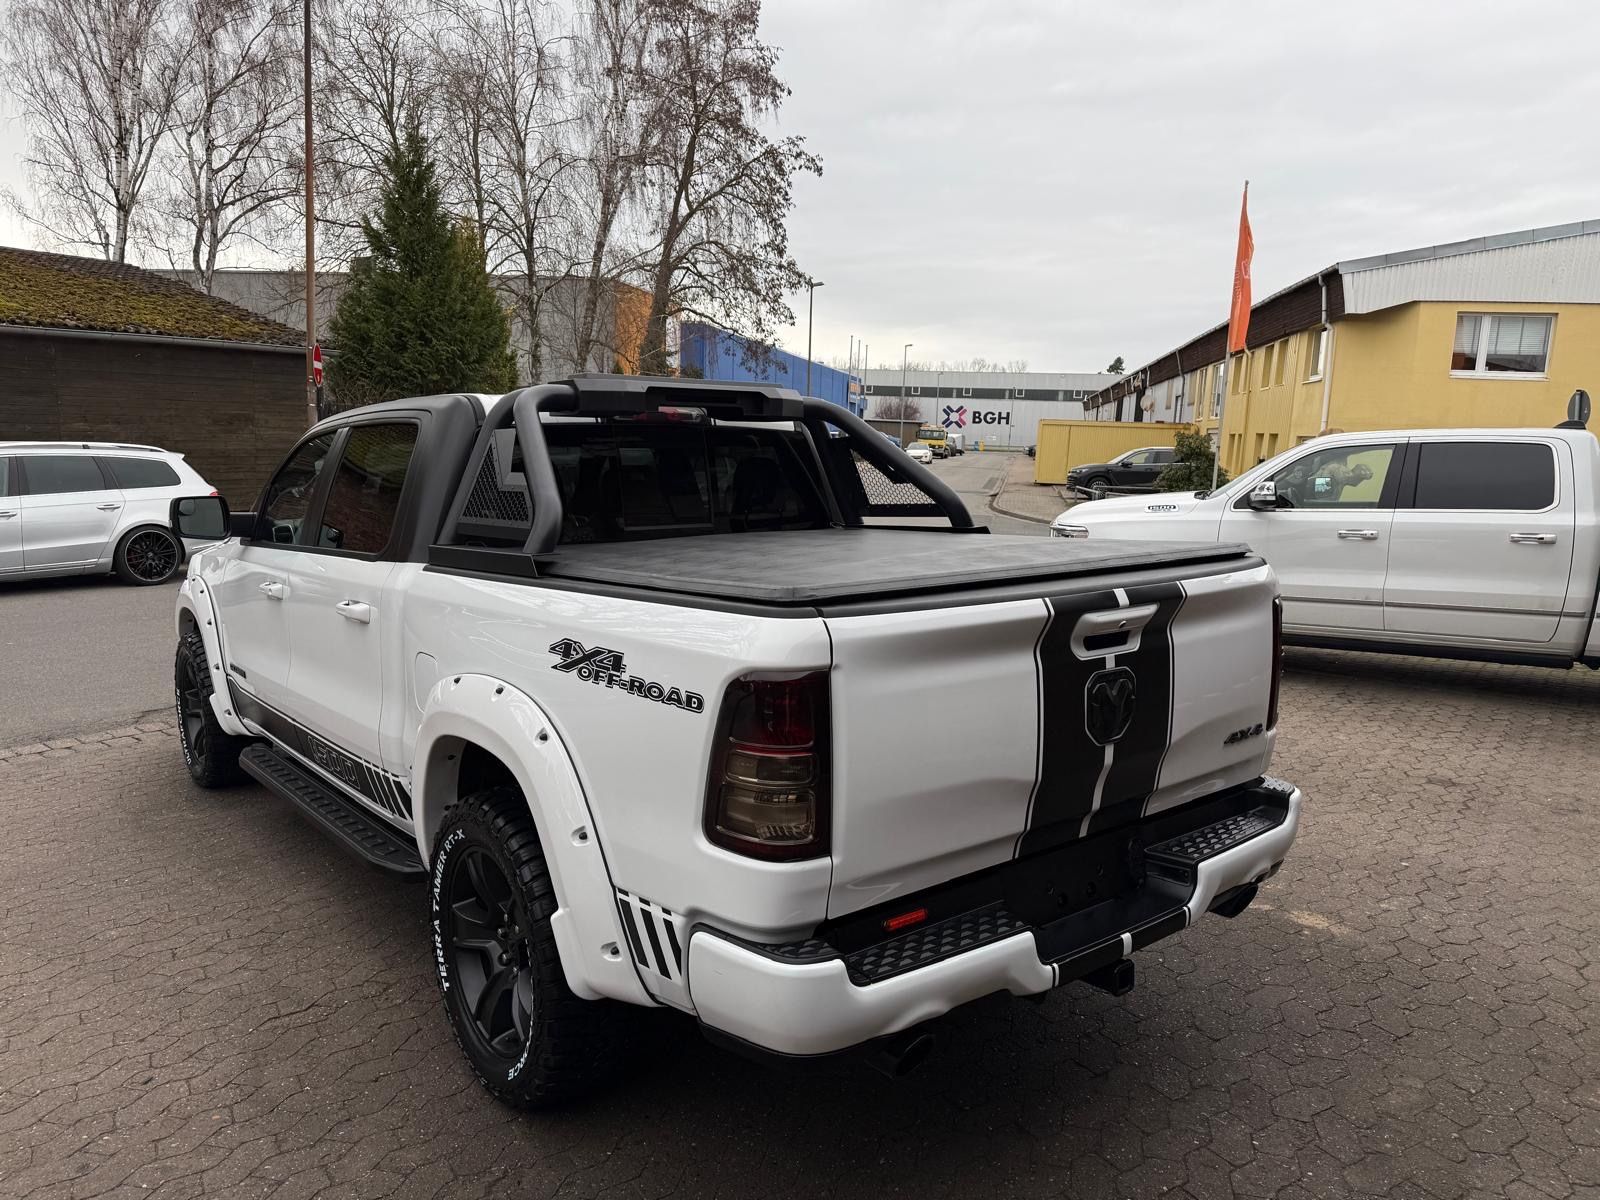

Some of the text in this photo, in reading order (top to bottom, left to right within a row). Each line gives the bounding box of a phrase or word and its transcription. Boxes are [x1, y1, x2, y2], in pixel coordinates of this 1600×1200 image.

[972, 410, 1010, 425] BGH
[577, 665, 705, 714] OFF-ROAD
[432, 828, 466, 992] TERRA TAMER RT-X
